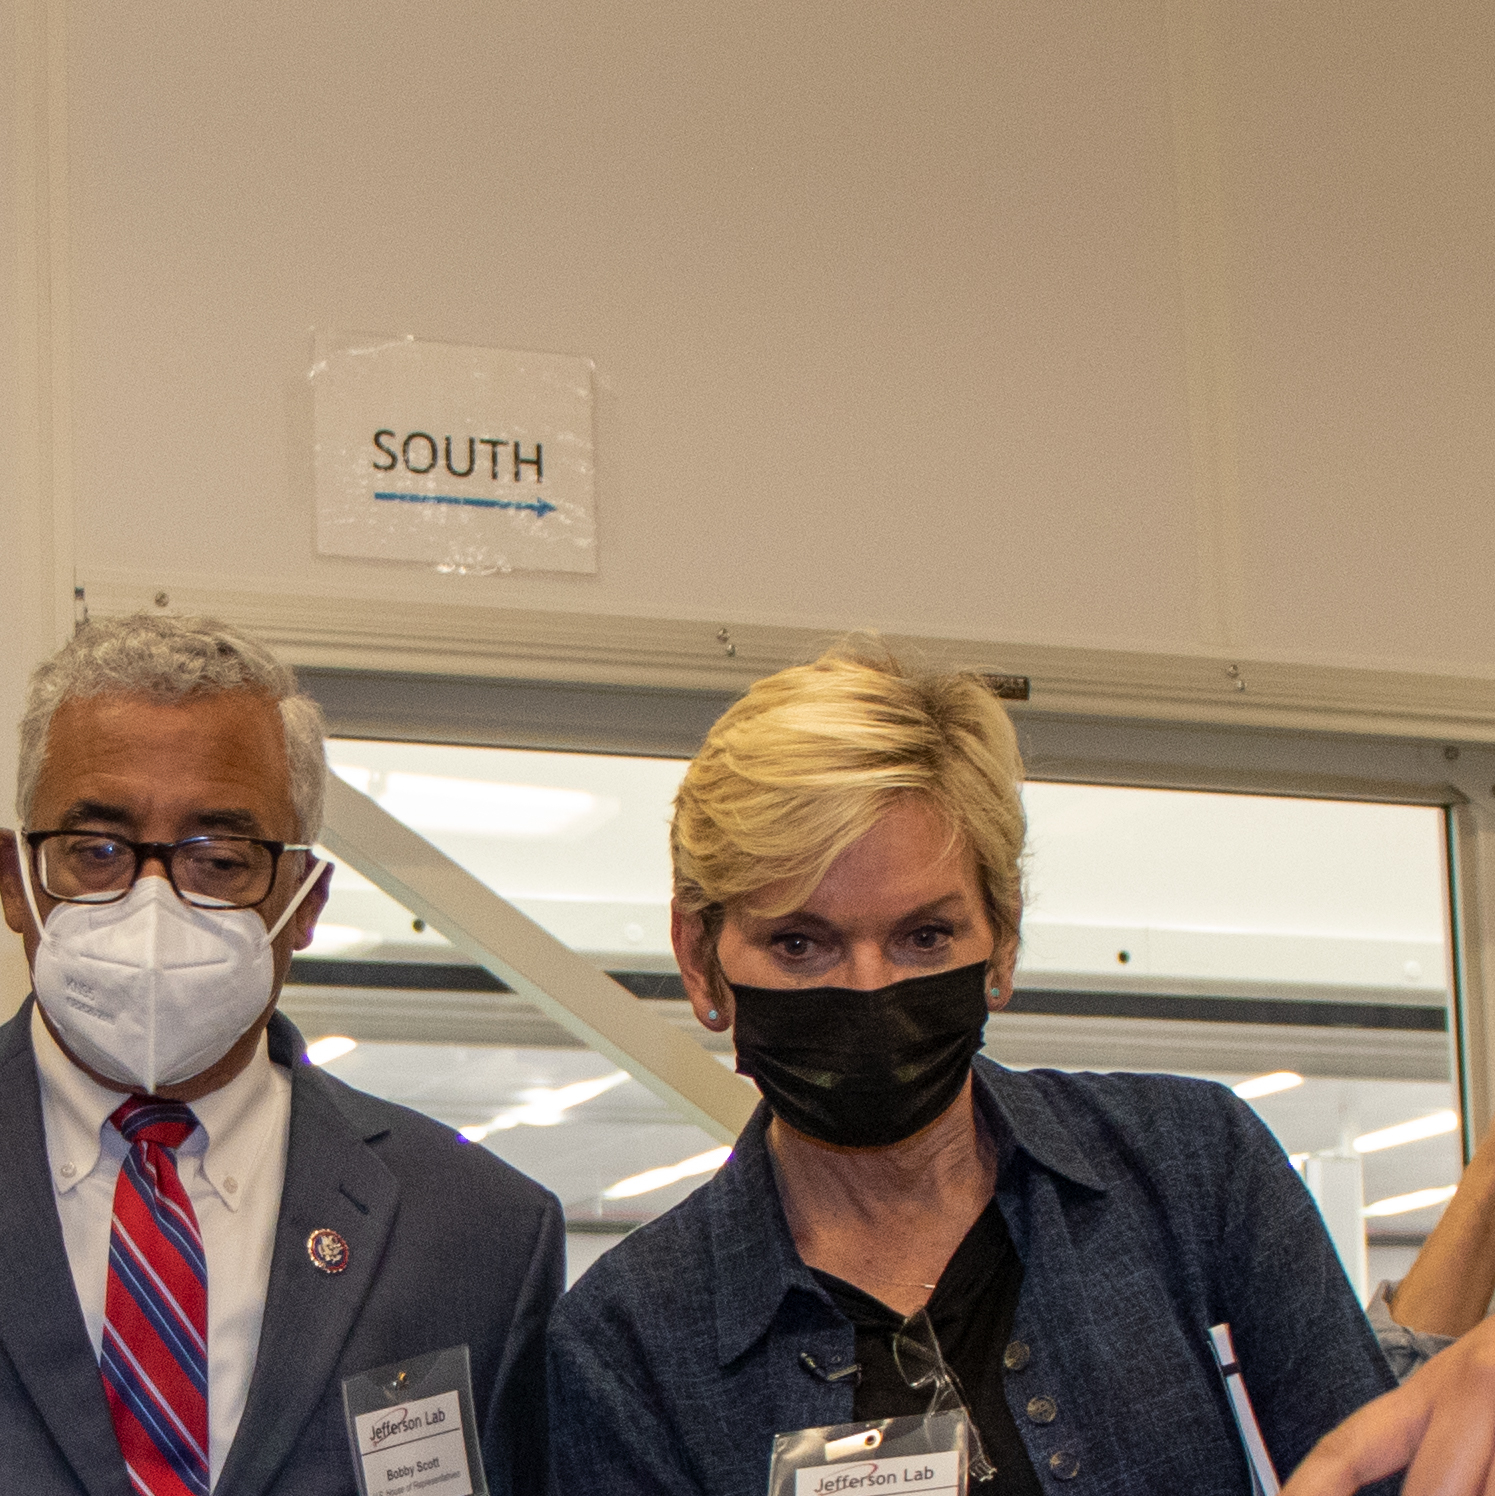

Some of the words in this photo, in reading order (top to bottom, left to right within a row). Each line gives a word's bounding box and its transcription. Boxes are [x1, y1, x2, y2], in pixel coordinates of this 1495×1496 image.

[372, 428, 543, 484] SOUTH
[370, 1417, 422, 1440] Jefferson
[425, 1408, 445, 1425] Lab
[386, 1466, 415, 1481] Bobby
[416, 1457, 440, 1472] Scott
[814, 1473, 897, 1493] Jefferson
[904, 1466, 934, 1482] Lab
